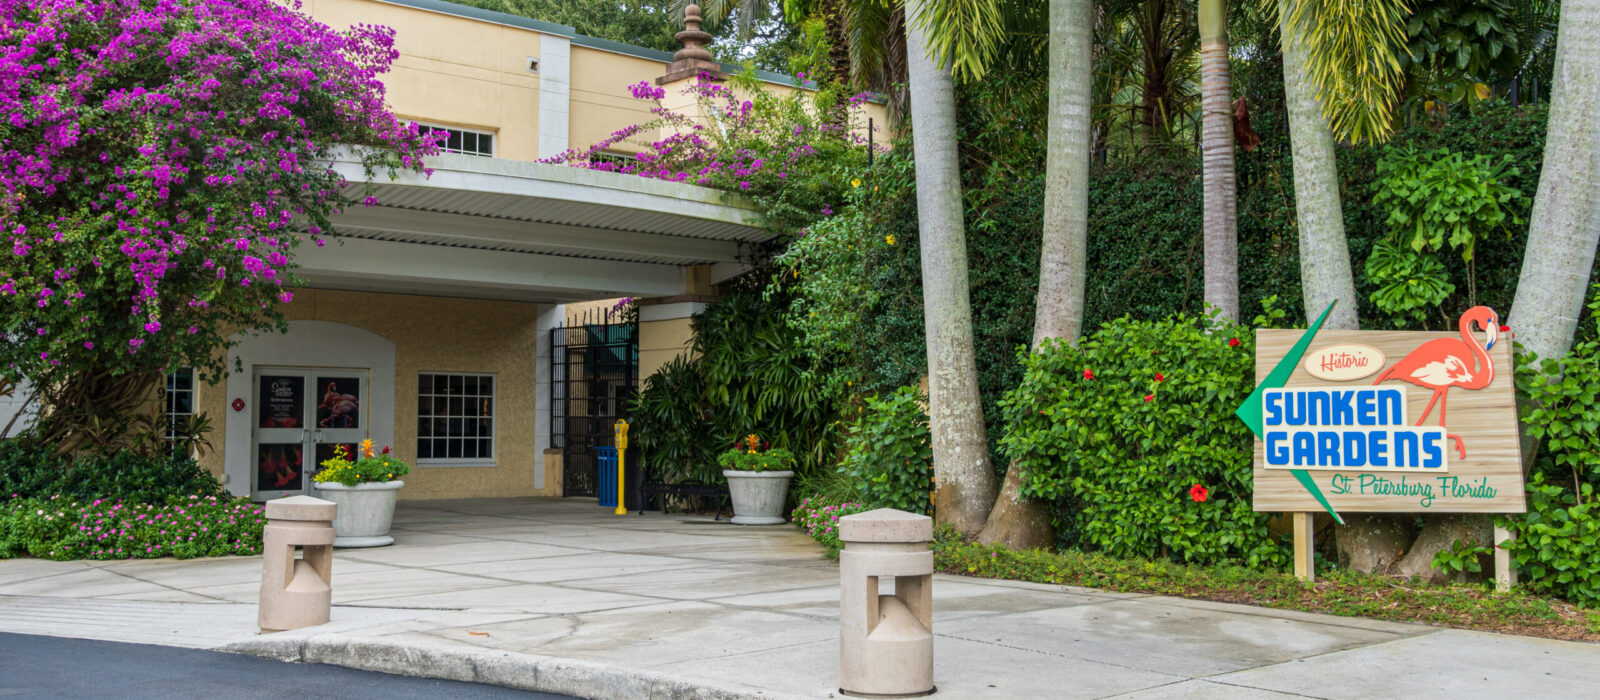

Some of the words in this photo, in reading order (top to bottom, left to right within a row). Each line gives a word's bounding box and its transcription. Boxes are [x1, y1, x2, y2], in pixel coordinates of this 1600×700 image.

[1320, 351, 1369, 372] Historic
[1266, 389, 1403, 426] SUNKEN
[1266, 430, 1442, 468] GARDENS
[1330, 473, 1355, 495] St.
[1357, 473, 1436, 508] Petersburg,
[1436, 476, 1498, 500] Florida
